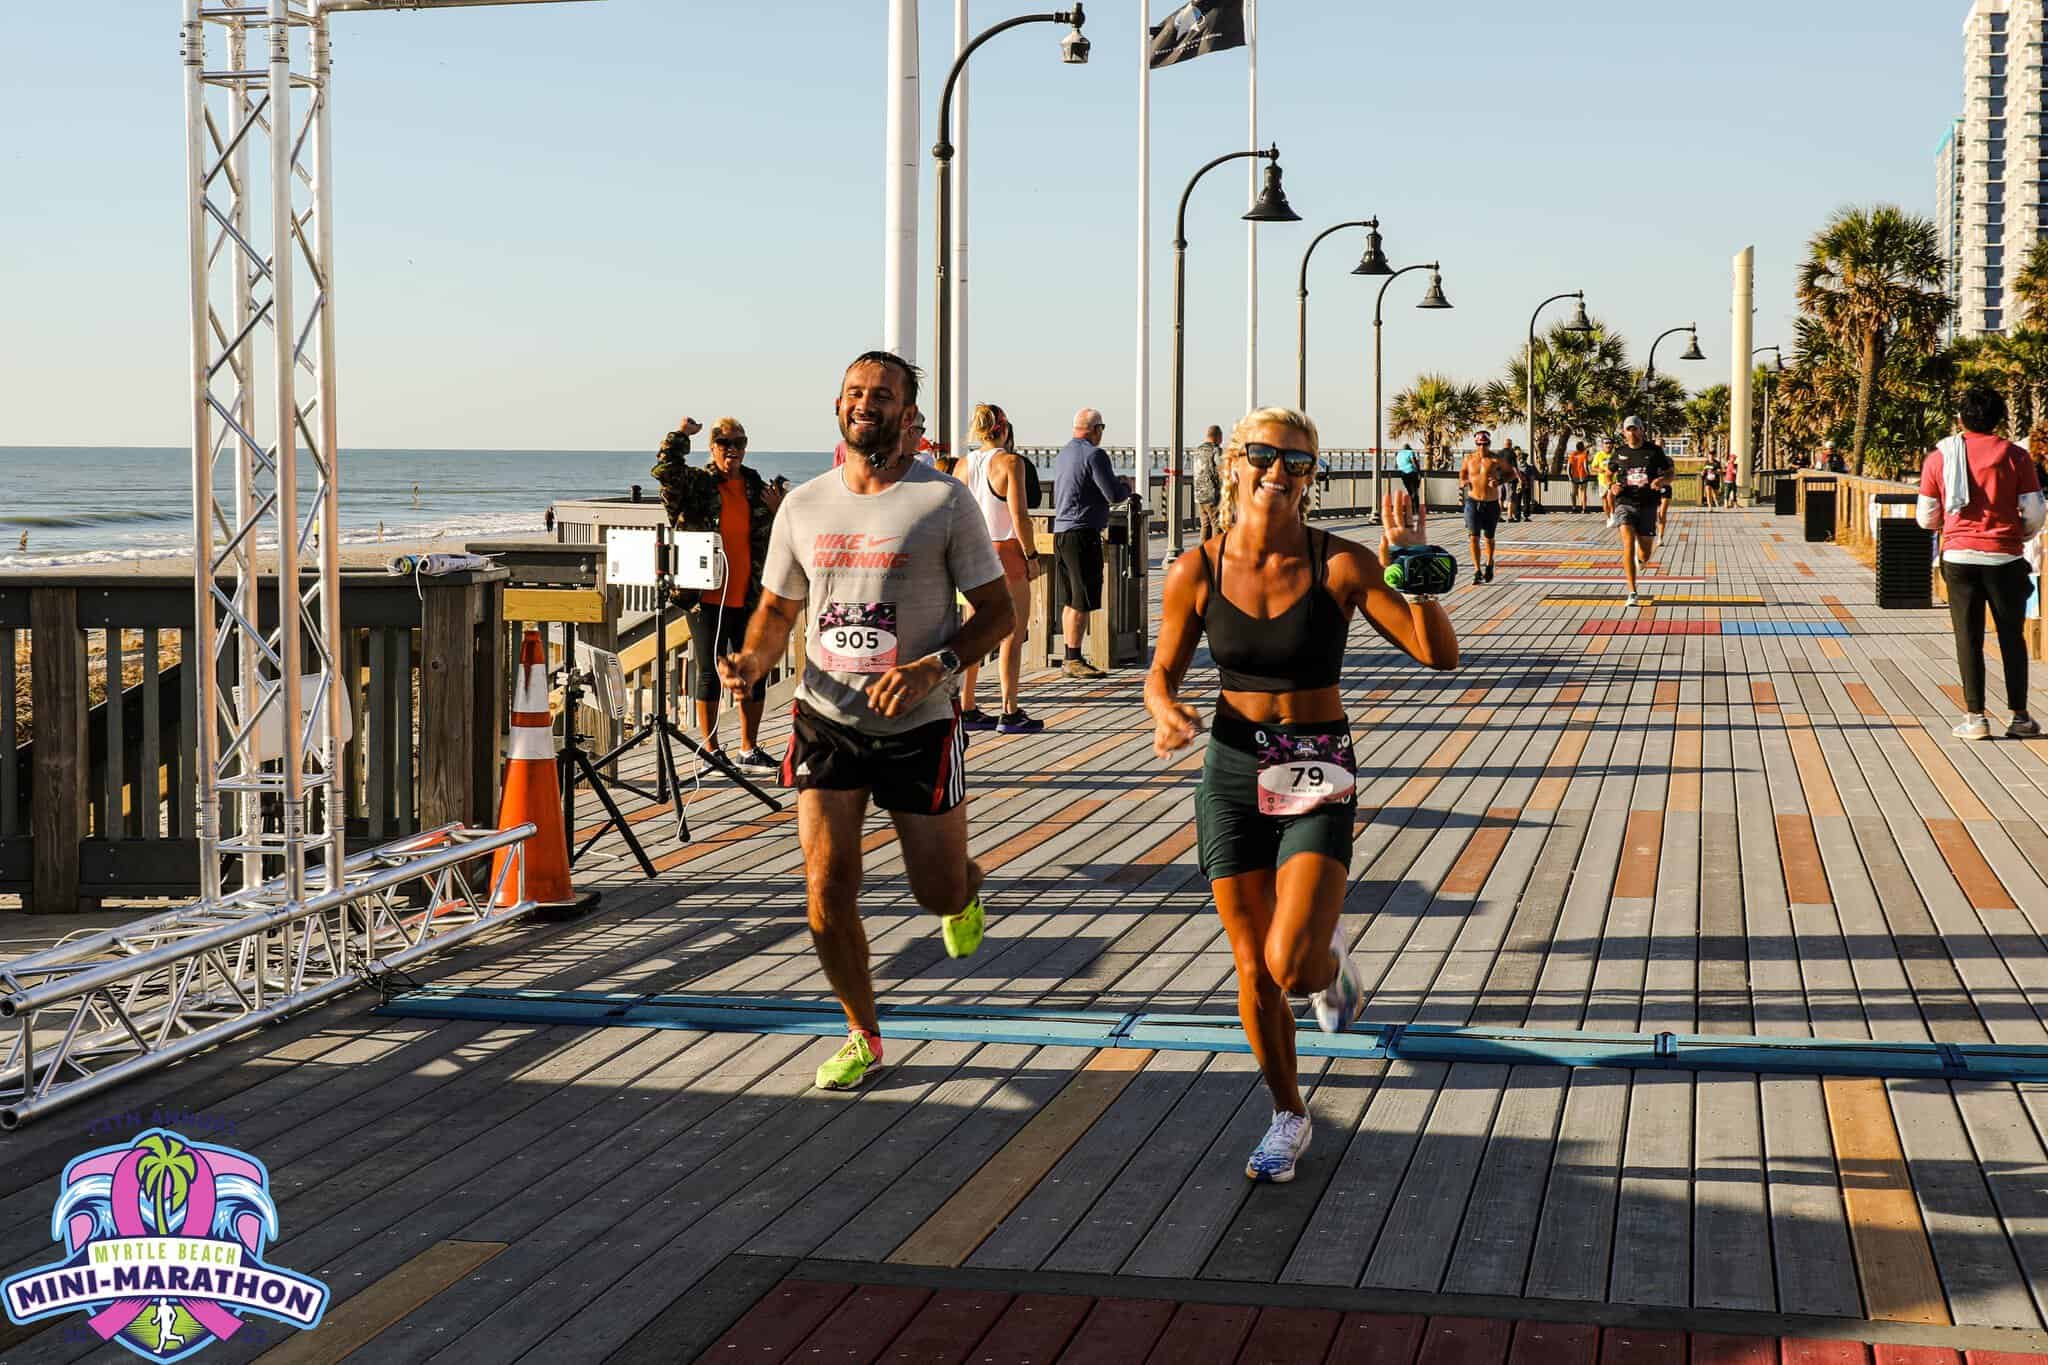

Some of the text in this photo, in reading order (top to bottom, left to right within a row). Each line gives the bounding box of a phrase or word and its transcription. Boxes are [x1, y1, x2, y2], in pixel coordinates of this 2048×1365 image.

[814, 533, 865, 551] NIKE
[812, 552, 912, 568] RUNNING
[835, 631, 879, 649] 905
[1290, 766, 1324, 787] 79
